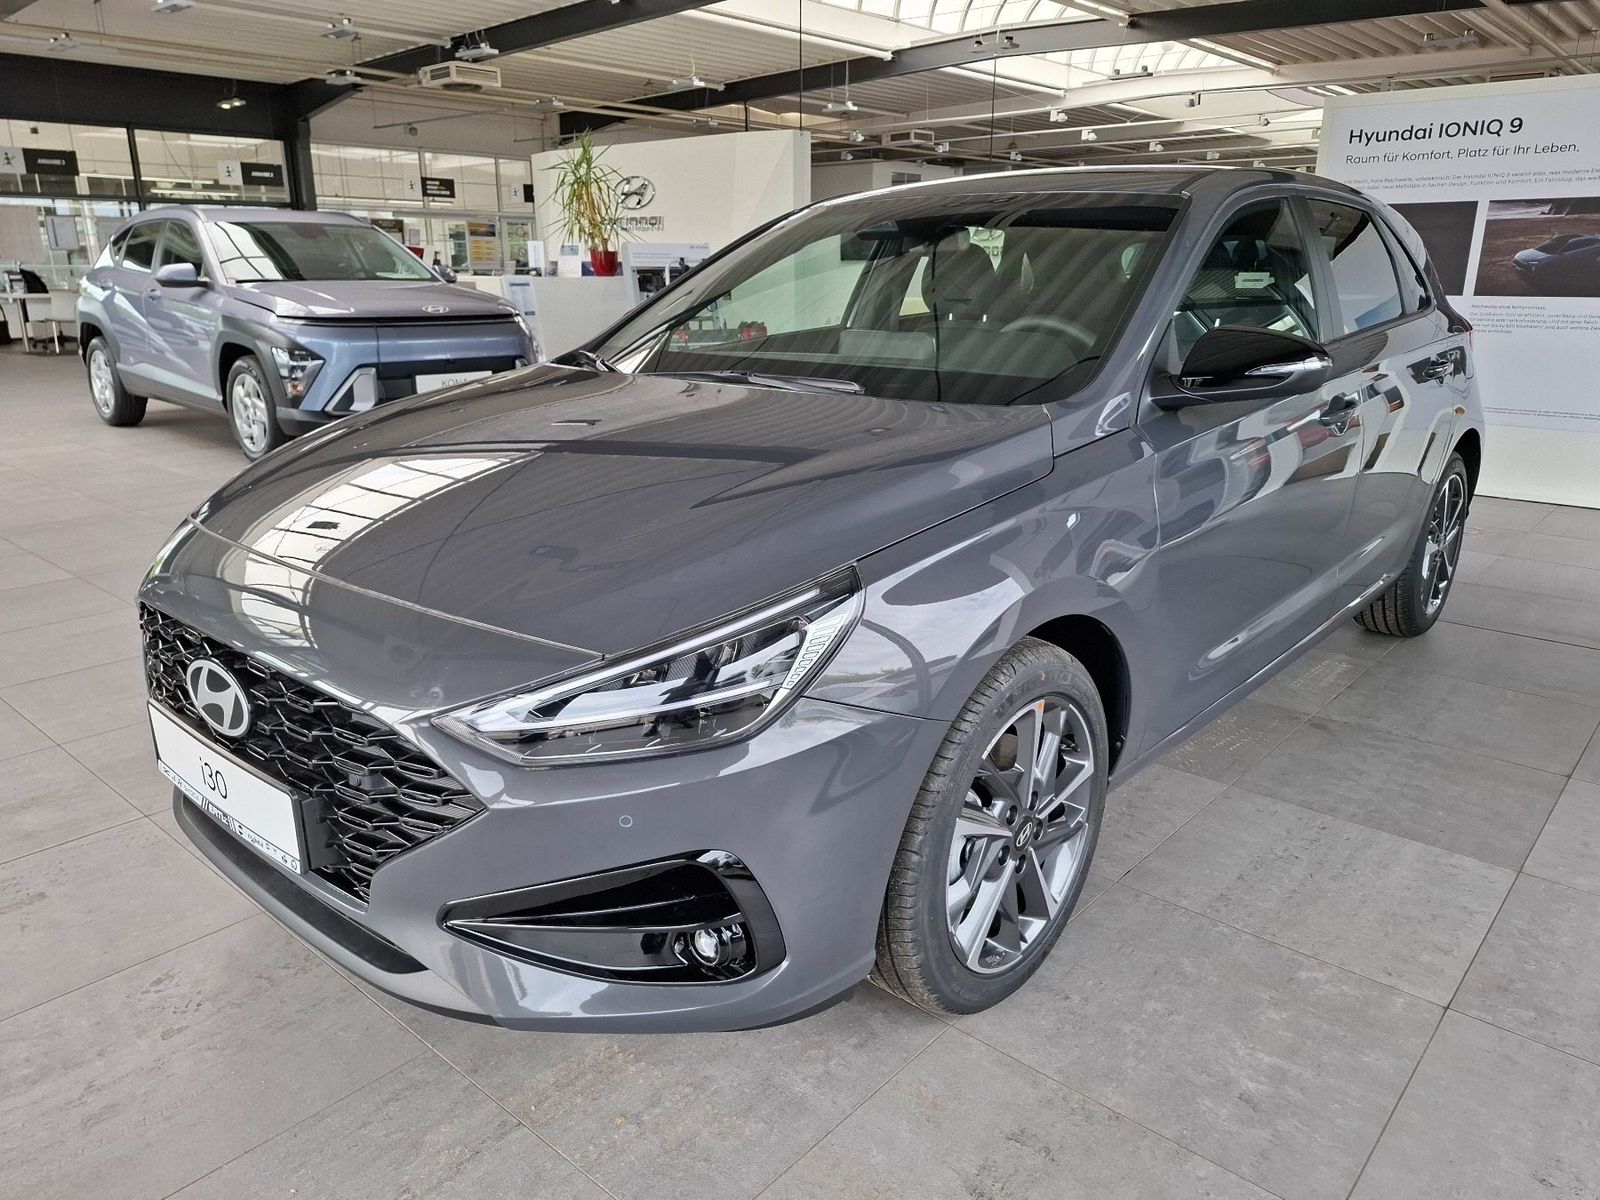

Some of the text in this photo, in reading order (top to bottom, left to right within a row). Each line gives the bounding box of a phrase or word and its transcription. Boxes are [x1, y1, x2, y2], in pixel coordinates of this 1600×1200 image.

[1348, 117, 1524, 147] Hyundai IONIQ 9
[1345, 154, 1380, 164] Raum
[1383, 151, 1400, 163] für
[1457, 147, 1489, 159] Platz
[1492, 145, 1510, 157] für
[1513, 144, 1532, 156] Ihr
[1534, 142, 1581, 155] Leben.
[200, 756, 228, 799] i30
